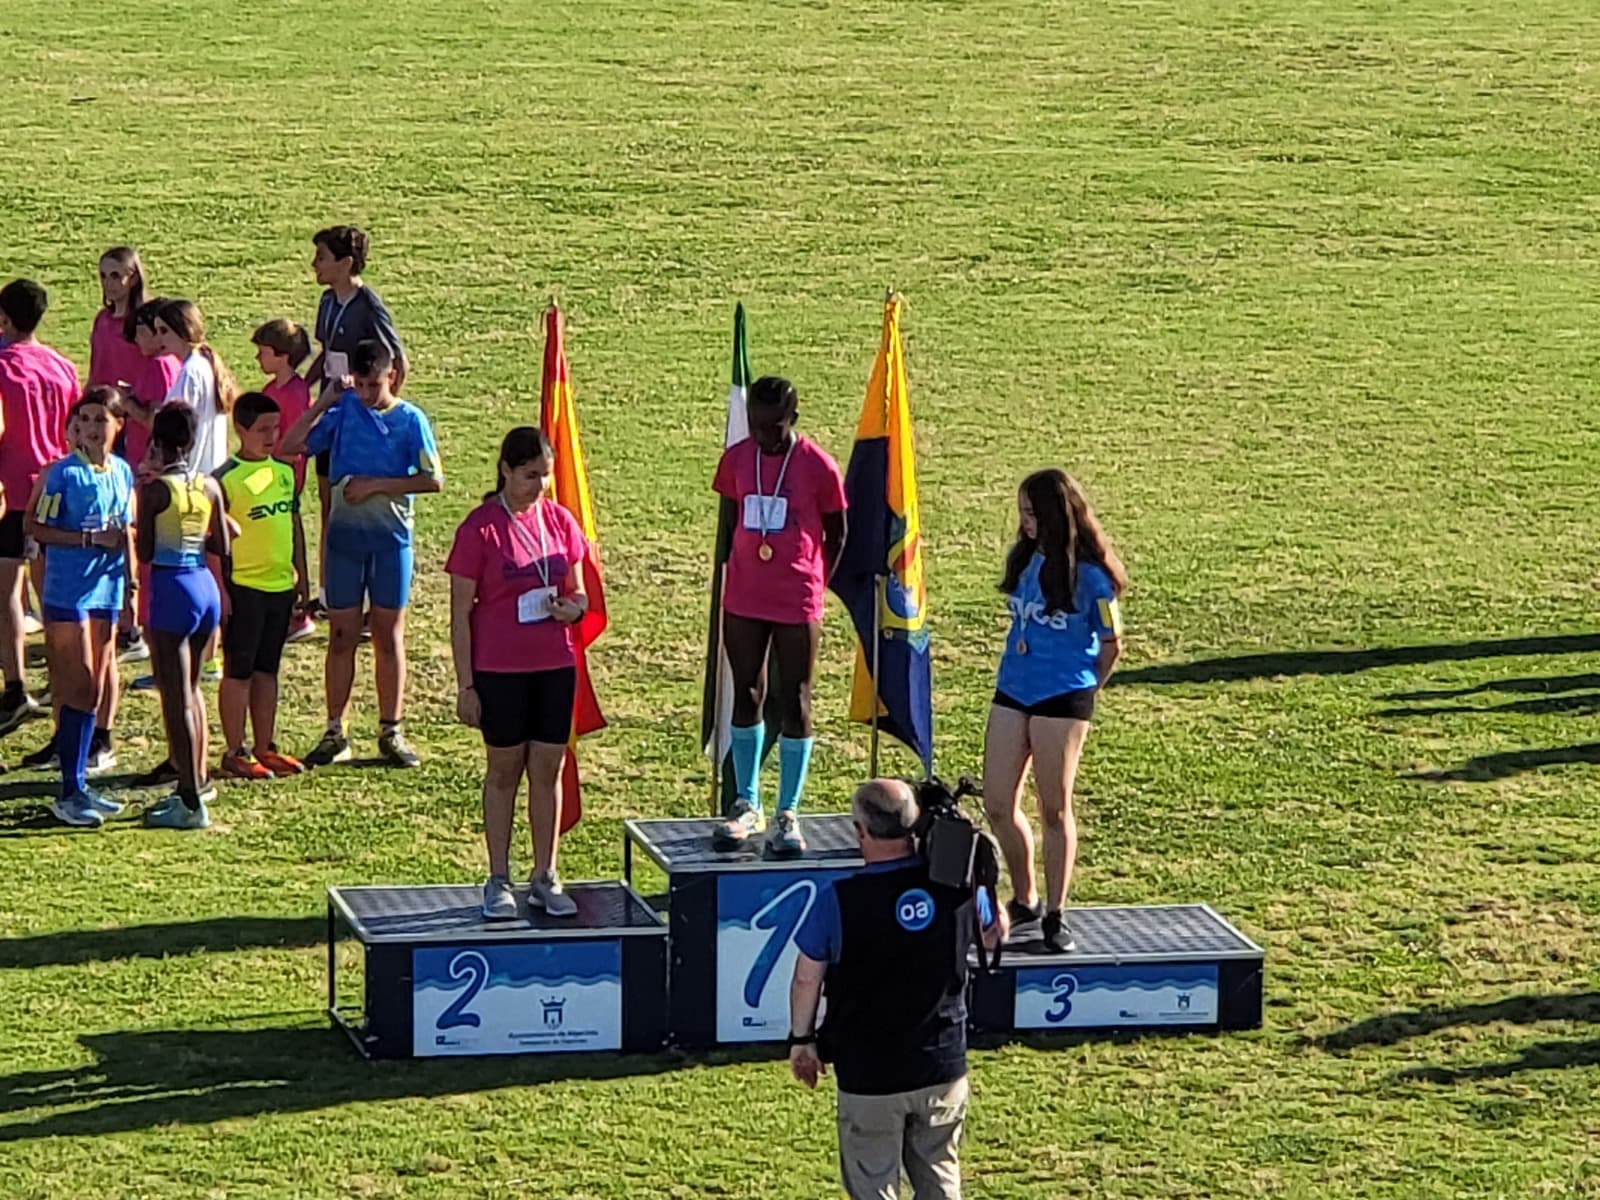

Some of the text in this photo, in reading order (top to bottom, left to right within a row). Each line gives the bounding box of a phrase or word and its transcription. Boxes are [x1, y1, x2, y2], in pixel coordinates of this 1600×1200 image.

[899, 899, 929, 922] oa
[744, 879, 818, 1009] 1
[435, 950, 490, 1030] 2
[1044, 973, 1078, 1023] 3
